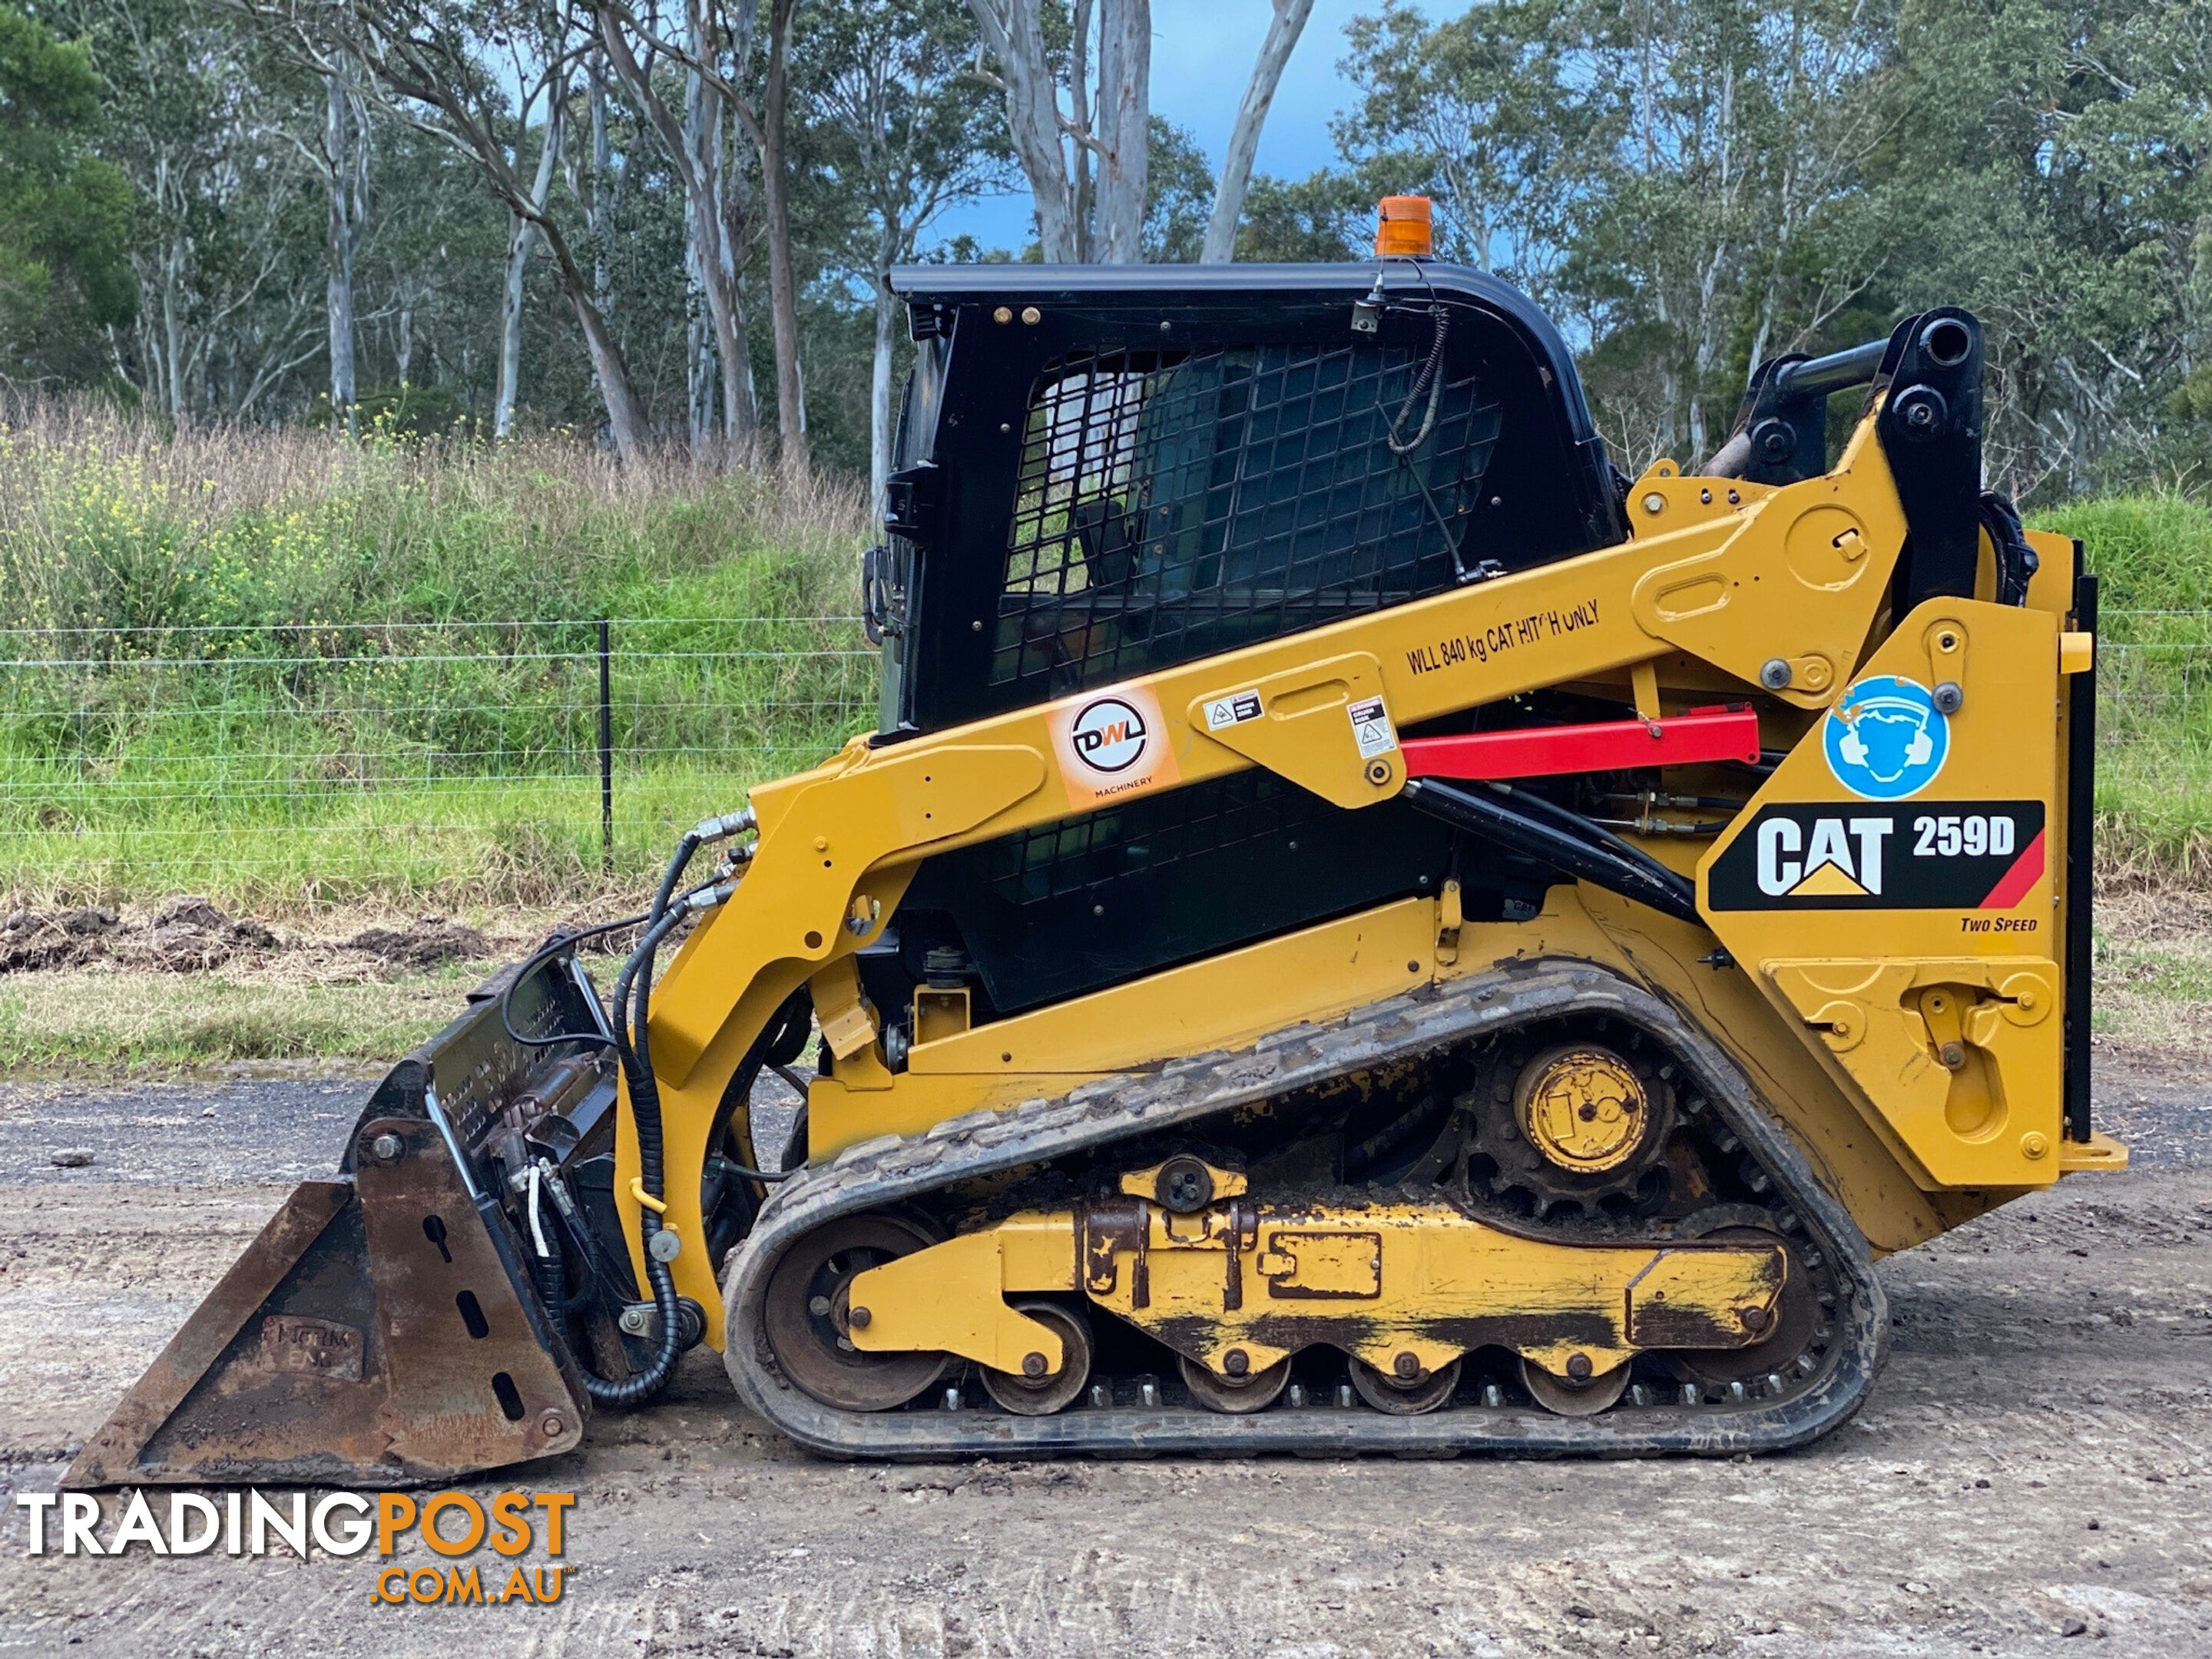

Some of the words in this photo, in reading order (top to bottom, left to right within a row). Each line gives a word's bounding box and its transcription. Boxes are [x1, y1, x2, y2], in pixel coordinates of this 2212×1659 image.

[1406, 646, 1441, 676] WLL
[1439, 637, 1466, 667] 840
[1465, 635, 1488, 663] kg
[1486, 621, 1516, 652] CAT
[1073, 720, 1146, 752] DWL
[1095, 776, 1152, 799] MACHINERY
[1757, 817, 1893, 896] CAT
[1912, 816, 2015, 856] 259D
